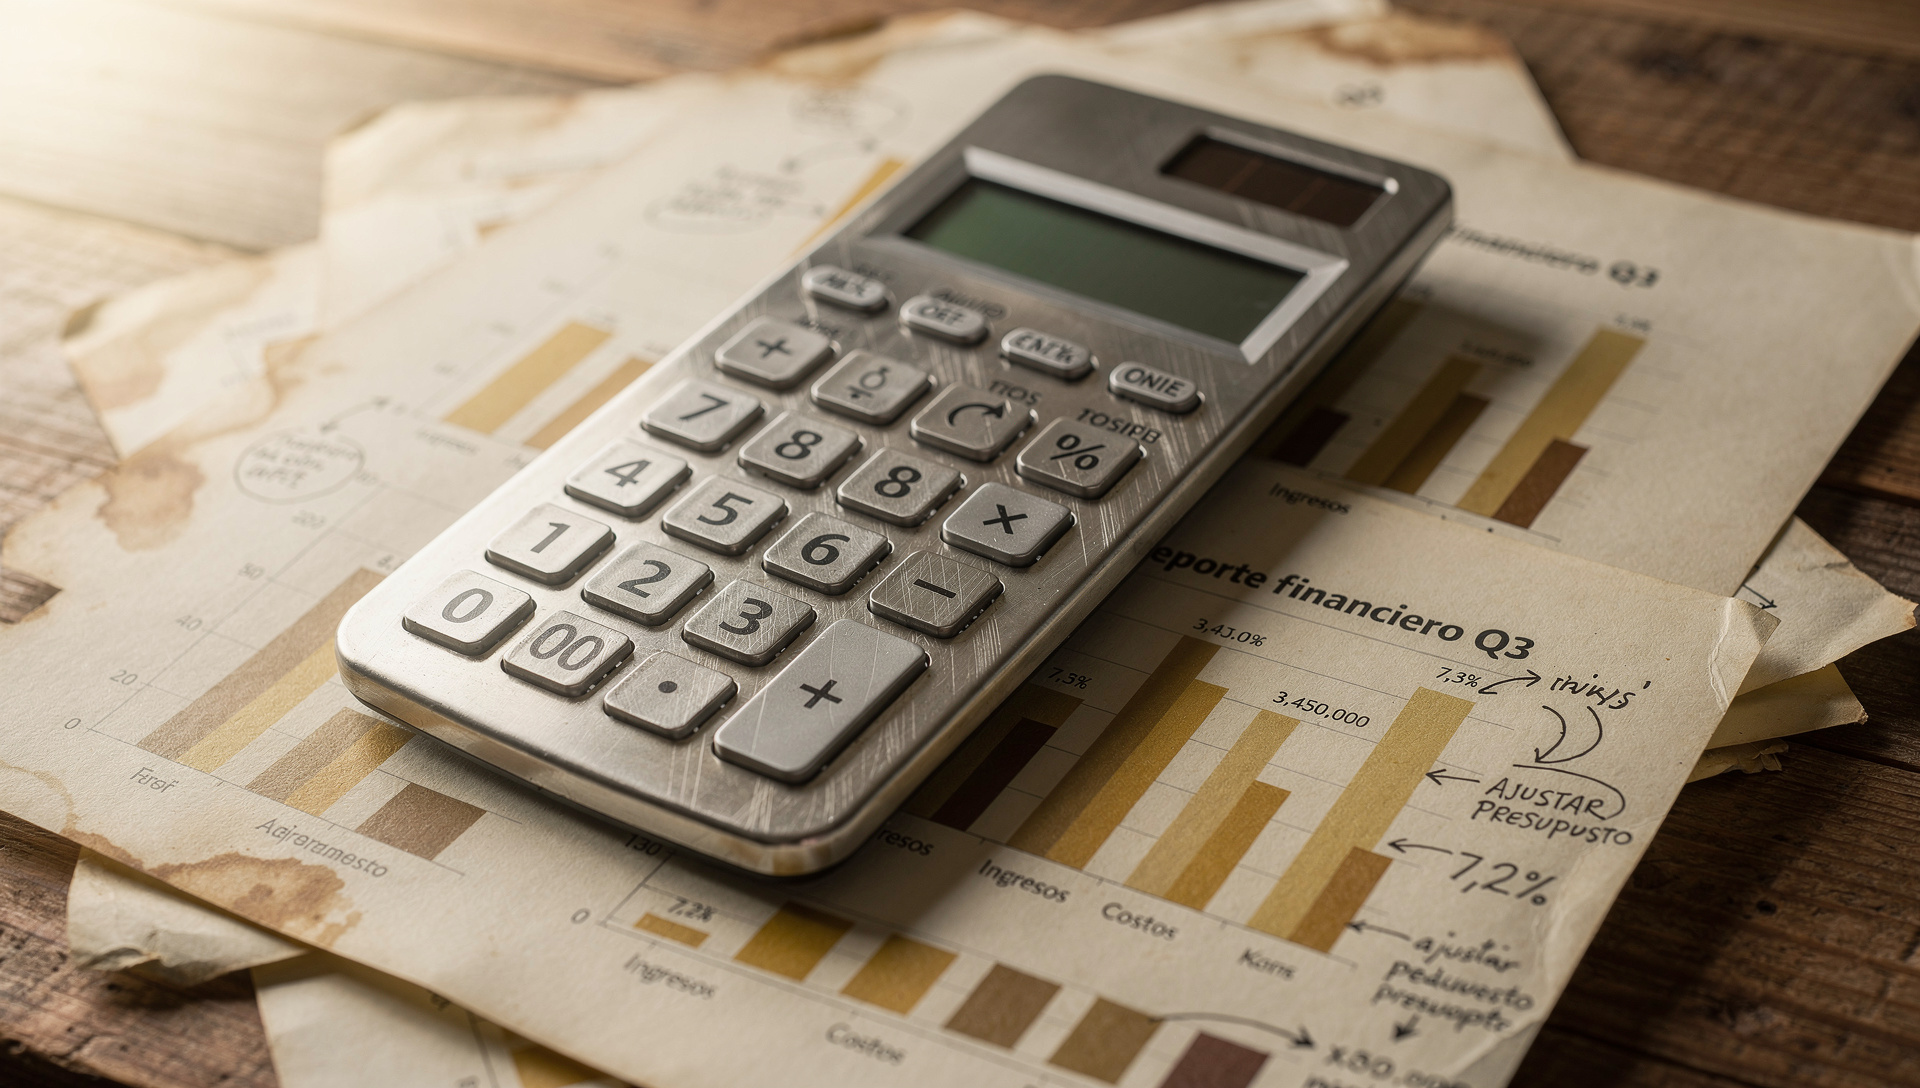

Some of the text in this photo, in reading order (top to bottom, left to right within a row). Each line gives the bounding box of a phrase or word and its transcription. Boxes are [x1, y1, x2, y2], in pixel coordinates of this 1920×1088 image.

[1123, 366, 1186, 398] ONIE
[678, 393, 729, 421] 7
[774, 429, 825, 460] 8
[604, 459, 652, 487] 4
[873, 465, 924, 498] 8
[695, 492, 755, 526] 5
[1268, 482, 1352, 516] Ingresos
[530, 521, 571, 554] 1
[800, 533, 852, 566] 6
[617, 559, 672, 599] 2
[441, 588, 494, 624] 0
[718, 597, 774, 636] 3
[1150, 546, 1536, 661] eporte financiero Q3
[529, 622, 606, 672] 00
[109, 669, 138, 687] 20
[64, 717, 82, 731] 0
[1271, 690, 1371, 728] 3,450,000
[1484, 777, 1608, 822] AJUSTAR
[1470, 799, 1634, 848] PRESUPUSTO
[876, 828, 935, 857] resos
[977, 858, 1071, 905] Ingresos
[1449, 850, 1558, 907] 7,2%
[571, 907, 592, 925] 0
[1101, 901, 1178, 942] Costos
[623, 953, 717, 1000] Ingresos
[824, 1021, 906, 1067] Costos
